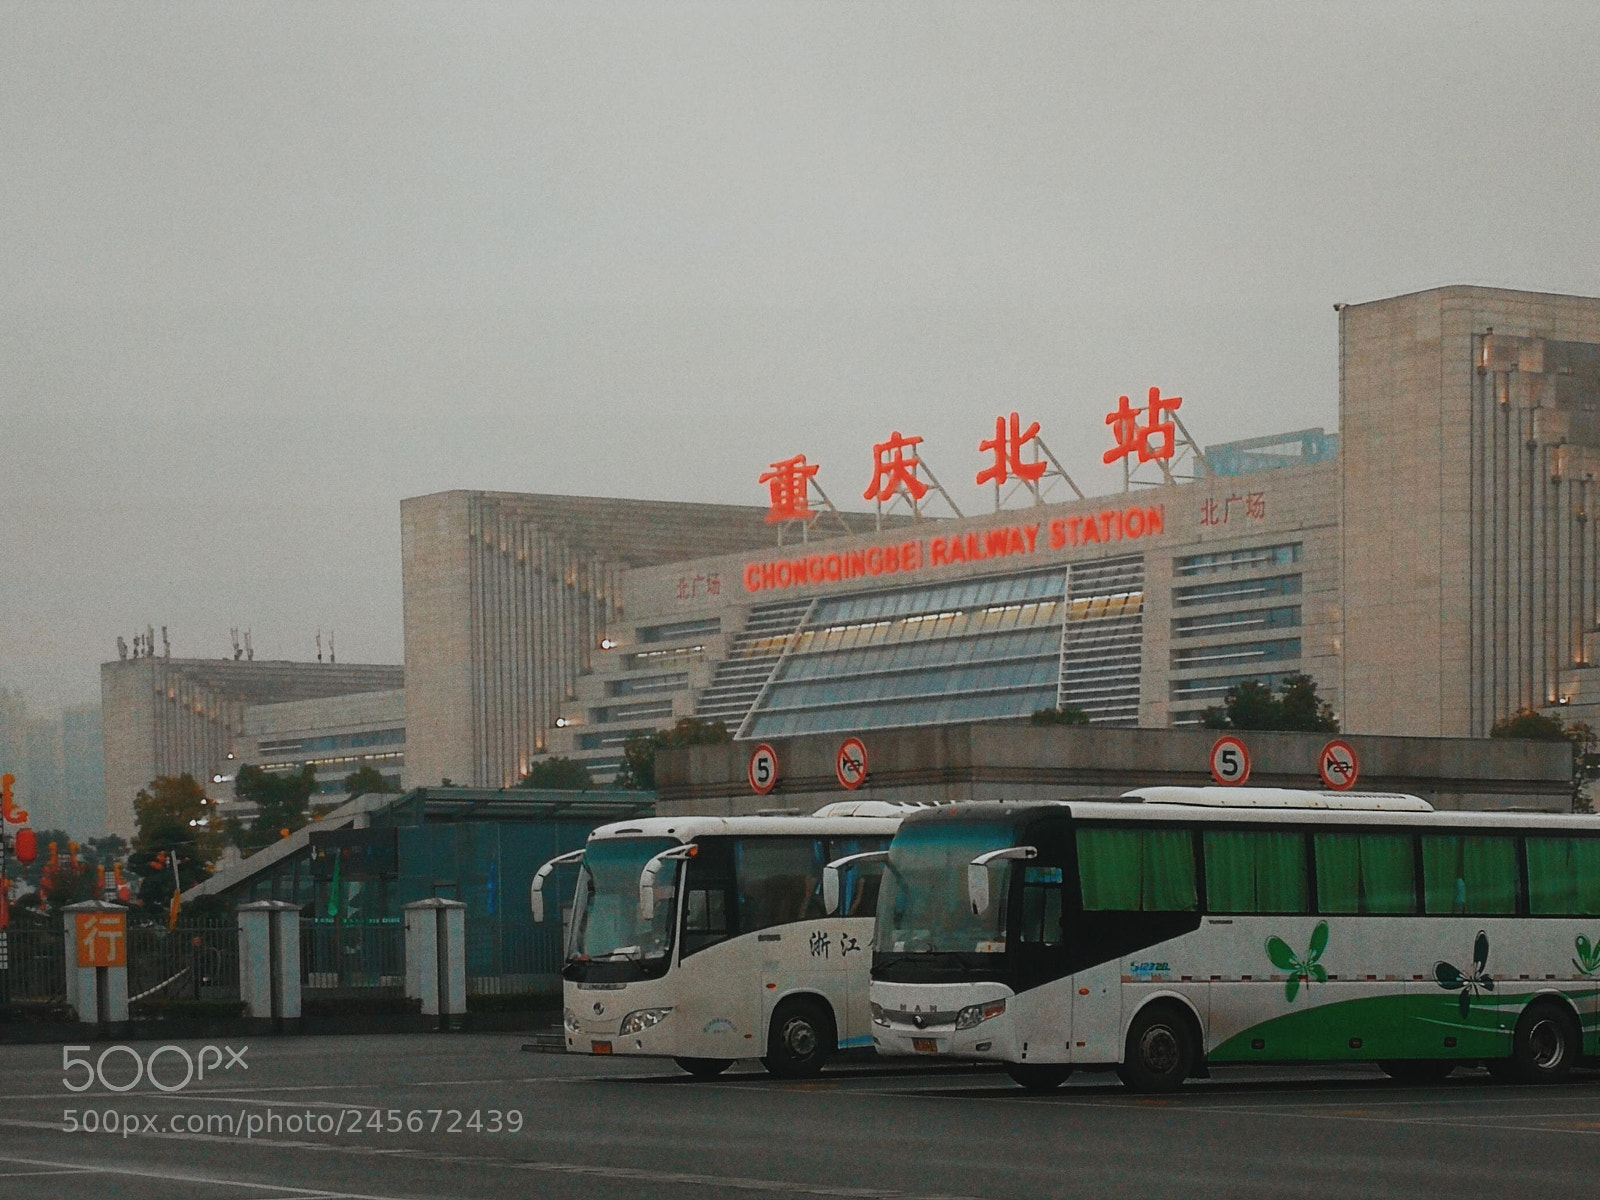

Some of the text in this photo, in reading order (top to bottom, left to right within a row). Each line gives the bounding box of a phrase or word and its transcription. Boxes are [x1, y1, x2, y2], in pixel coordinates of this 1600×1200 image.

[758, 386, 1183, 525] 重庆北站
[1200, 491, 1265, 526] 北广场
[743, 504, 1165, 592] CHONGQINGBEI RAILWAY STATION
[757, 757, 770, 782] 5
[1221, 750, 1239, 776] 5
[83, 916, 123, 962] 行
[809, 930, 875, 959] 浙江
